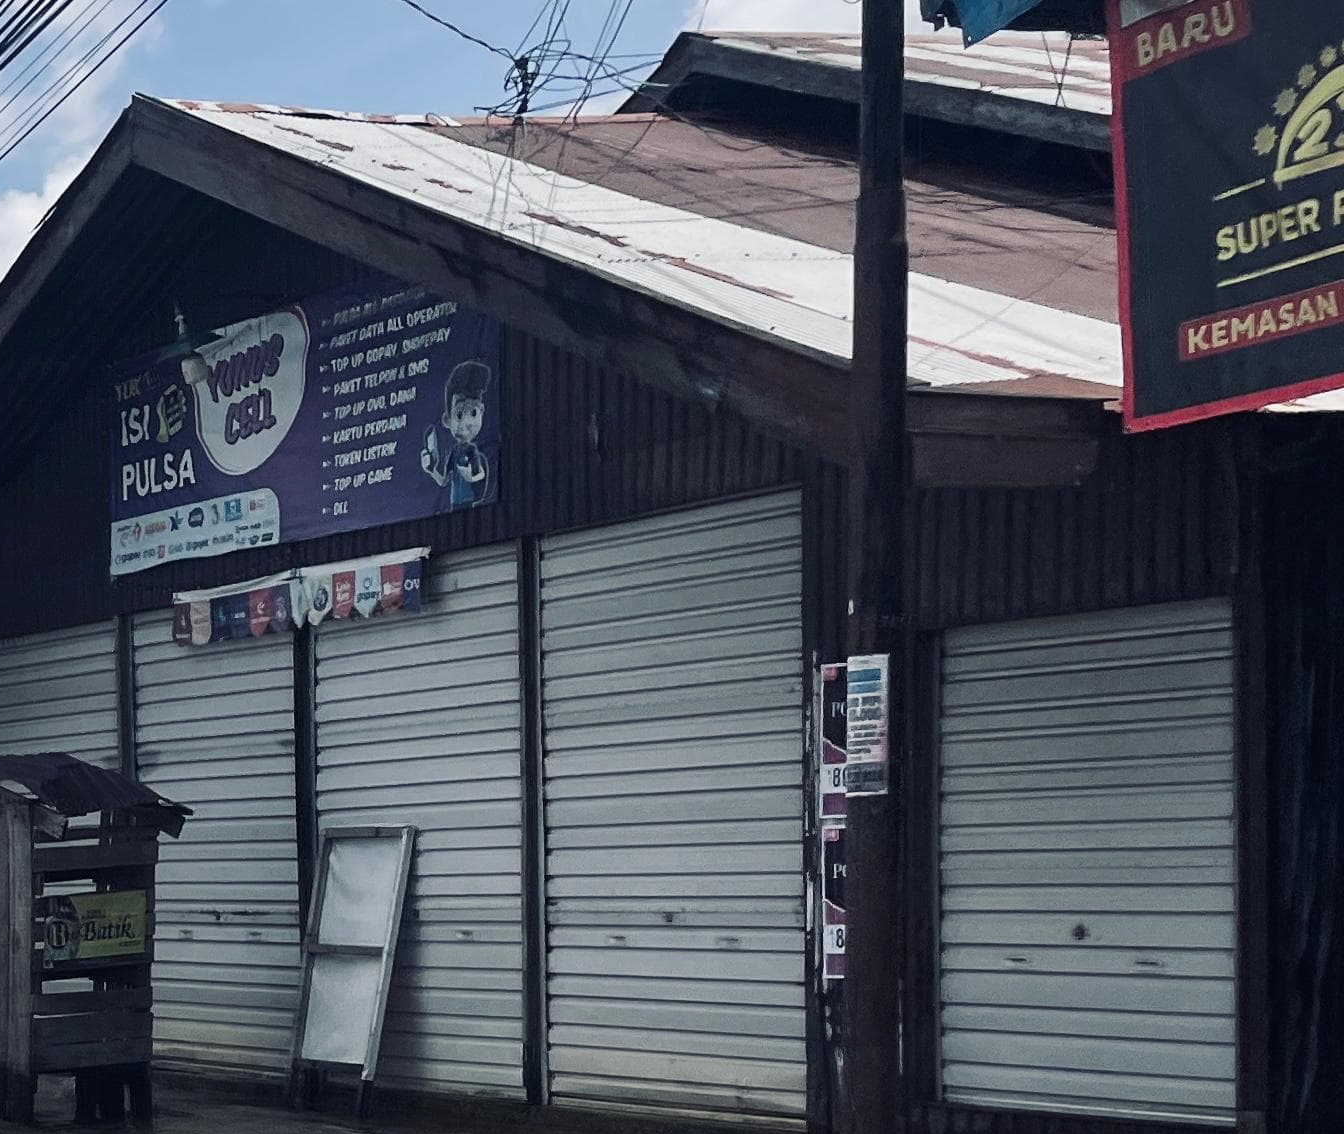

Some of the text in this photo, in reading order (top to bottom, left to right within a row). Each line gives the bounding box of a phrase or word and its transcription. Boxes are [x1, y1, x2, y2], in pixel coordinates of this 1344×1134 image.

[1136, 2, 1236, 67] BARU
[1216, 199, 1320, 261] SUPER
[359, 322, 384, 340] DATA
[387, 317, 404, 332] ALL
[406, 302, 458, 327] OPERATOR
[1187, 291, 1339, 355] KEMASAN
[331, 356, 349, 373] TOP
[352, 353, 364, 368] UP
[334, 378, 361, 396] PAKET
[408, 359, 430, 376] SMS
[224, 388, 276, 445] CELL
[334, 405, 351, 420] TOP
[353, 401, 365, 416] UP
[390, 387, 416, 406] DANA
[121, 405, 150, 446] ISI
[333, 414, 407, 444] KARTU PERDANA
[334, 441, 397, 467] TOKEN LISTRIK
[122, 449, 196, 501] PULSA
[334, 466, 393, 491] TOP UP GAME
